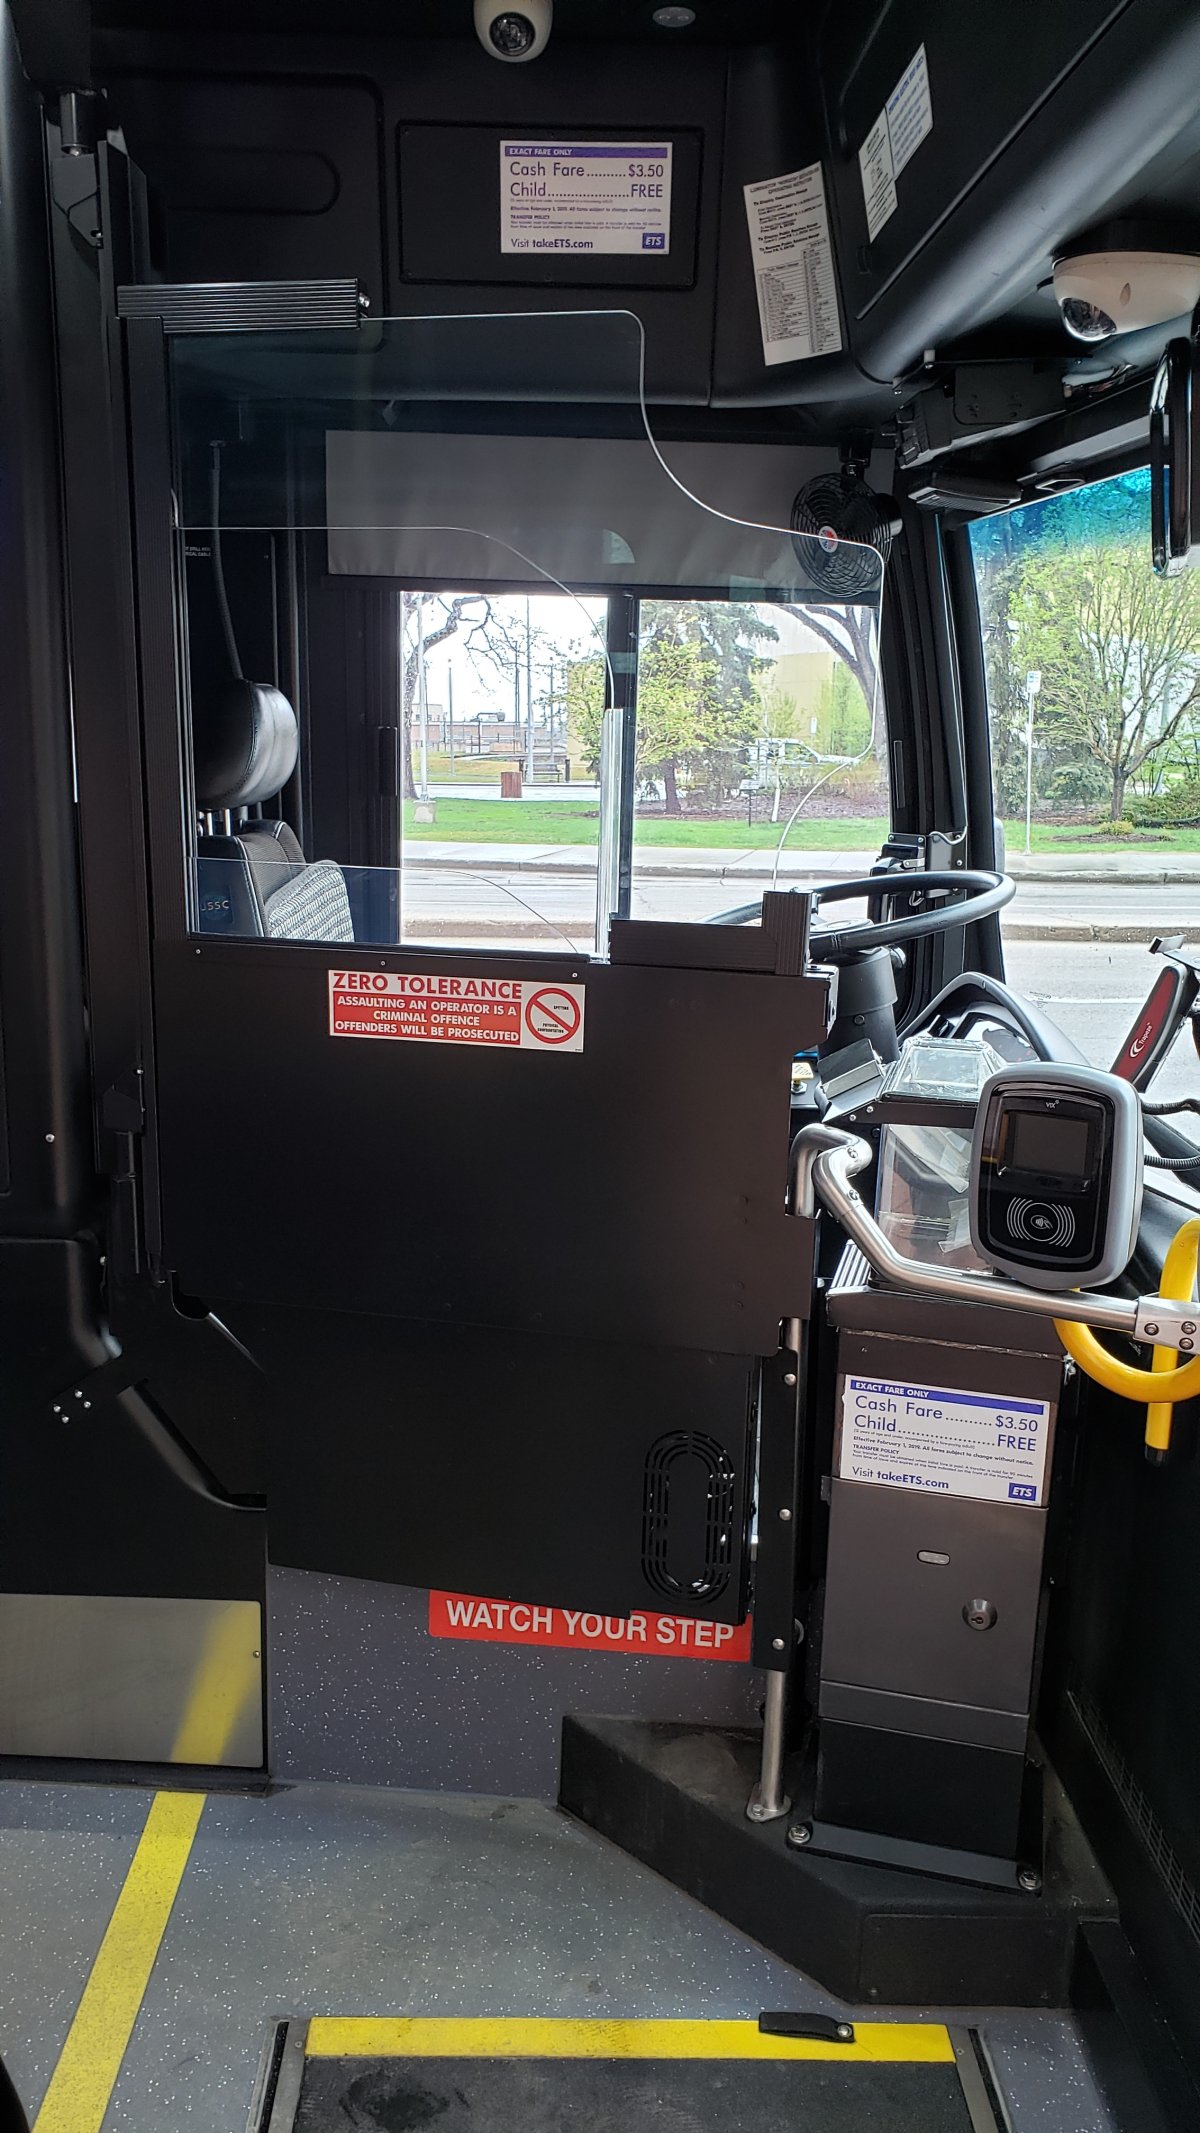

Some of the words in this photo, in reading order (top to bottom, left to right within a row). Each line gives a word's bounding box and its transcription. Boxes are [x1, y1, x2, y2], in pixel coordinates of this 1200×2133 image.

[509, 148, 532, 156] EXACT
[534, 148, 551, 156] FARE
[553, 149, 573, 157] ONLY
[510, 161, 546, 176] Cash
[553, 163, 585, 176] Fare
[628, 164, 664, 178] $3.50
[510, 182, 546, 197] Child
[631, 184, 663, 198] FREE
[511, 239, 529, 248] Visit
[532, 239, 593, 248] takeETS.com
[645, 236, 662, 246] ETS
[333, 972, 388, 991] ZERO
[397, 976, 522, 999] TOLERANCE
[337, 995, 405, 1009] ASSAULTING
[409, 1000, 427, 1010] AN
[430, 1001, 489, 1015] OPERATOR
[493, 1004, 504, 1016] IS
[507, 1005, 517, 1016] A
[373, 1010, 428, 1023] CRIMINAL
[430, 1014, 480, 1026] OFFENCE
[335, 1021, 398, 1034] OFFENDERS
[401, 1024, 427, 1036] WILL
[430, 1026, 445, 1037] BE
[447, 1027, 519, 1042] PROSECUTED
[856, 1382, 882, 1392] EXACT
[884, 1386, 904, 1395] FARE
[907, 1389, 929, 1398] ONLY
[855, 1395, 896, 1413] Cash
[906, 1402, 943, 1419] Fare
[995, 1415, 1038, 1432] $3.50
[854, 1414, 896, 1432] Child
[997, 1434, 1037, 1451] FREE
[852, 1443, 879, 1451] TRANSFER
[876, 1439, 900, 1447] February
[852, 1466, 873, 1478] Visit
[876, 1470, 949, 1489] takeETS.com
[1012, 1486, 1033, 1497] ETS
[446, 1600, 552, 1634] WATCH
[562, 1610, 647, 1642] YOUR
[655, 1617, 734, 1648] STEP
